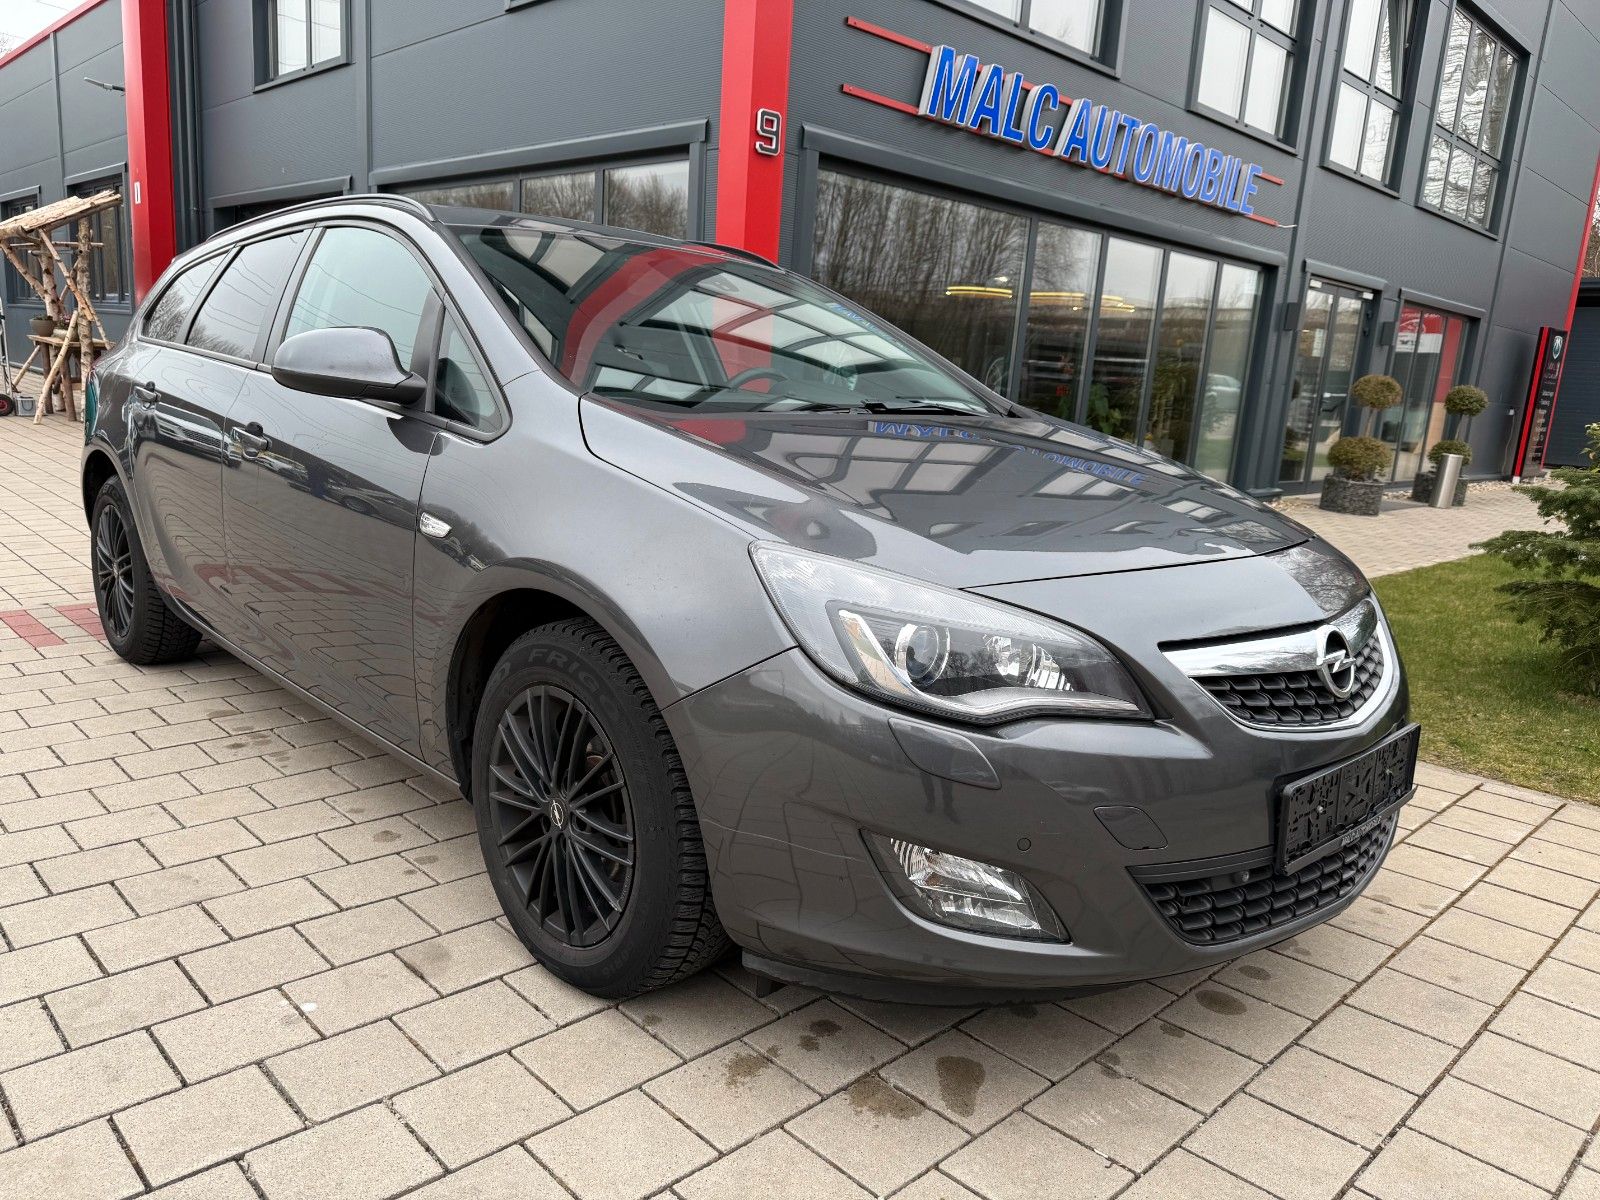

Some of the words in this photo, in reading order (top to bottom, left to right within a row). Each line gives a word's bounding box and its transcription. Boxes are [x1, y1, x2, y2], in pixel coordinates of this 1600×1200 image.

[755, 108, 782, 156] 9
[921, 45, 1060, 150] MALC
[1060, 98, 1263, 215] AUTOMOBILE
